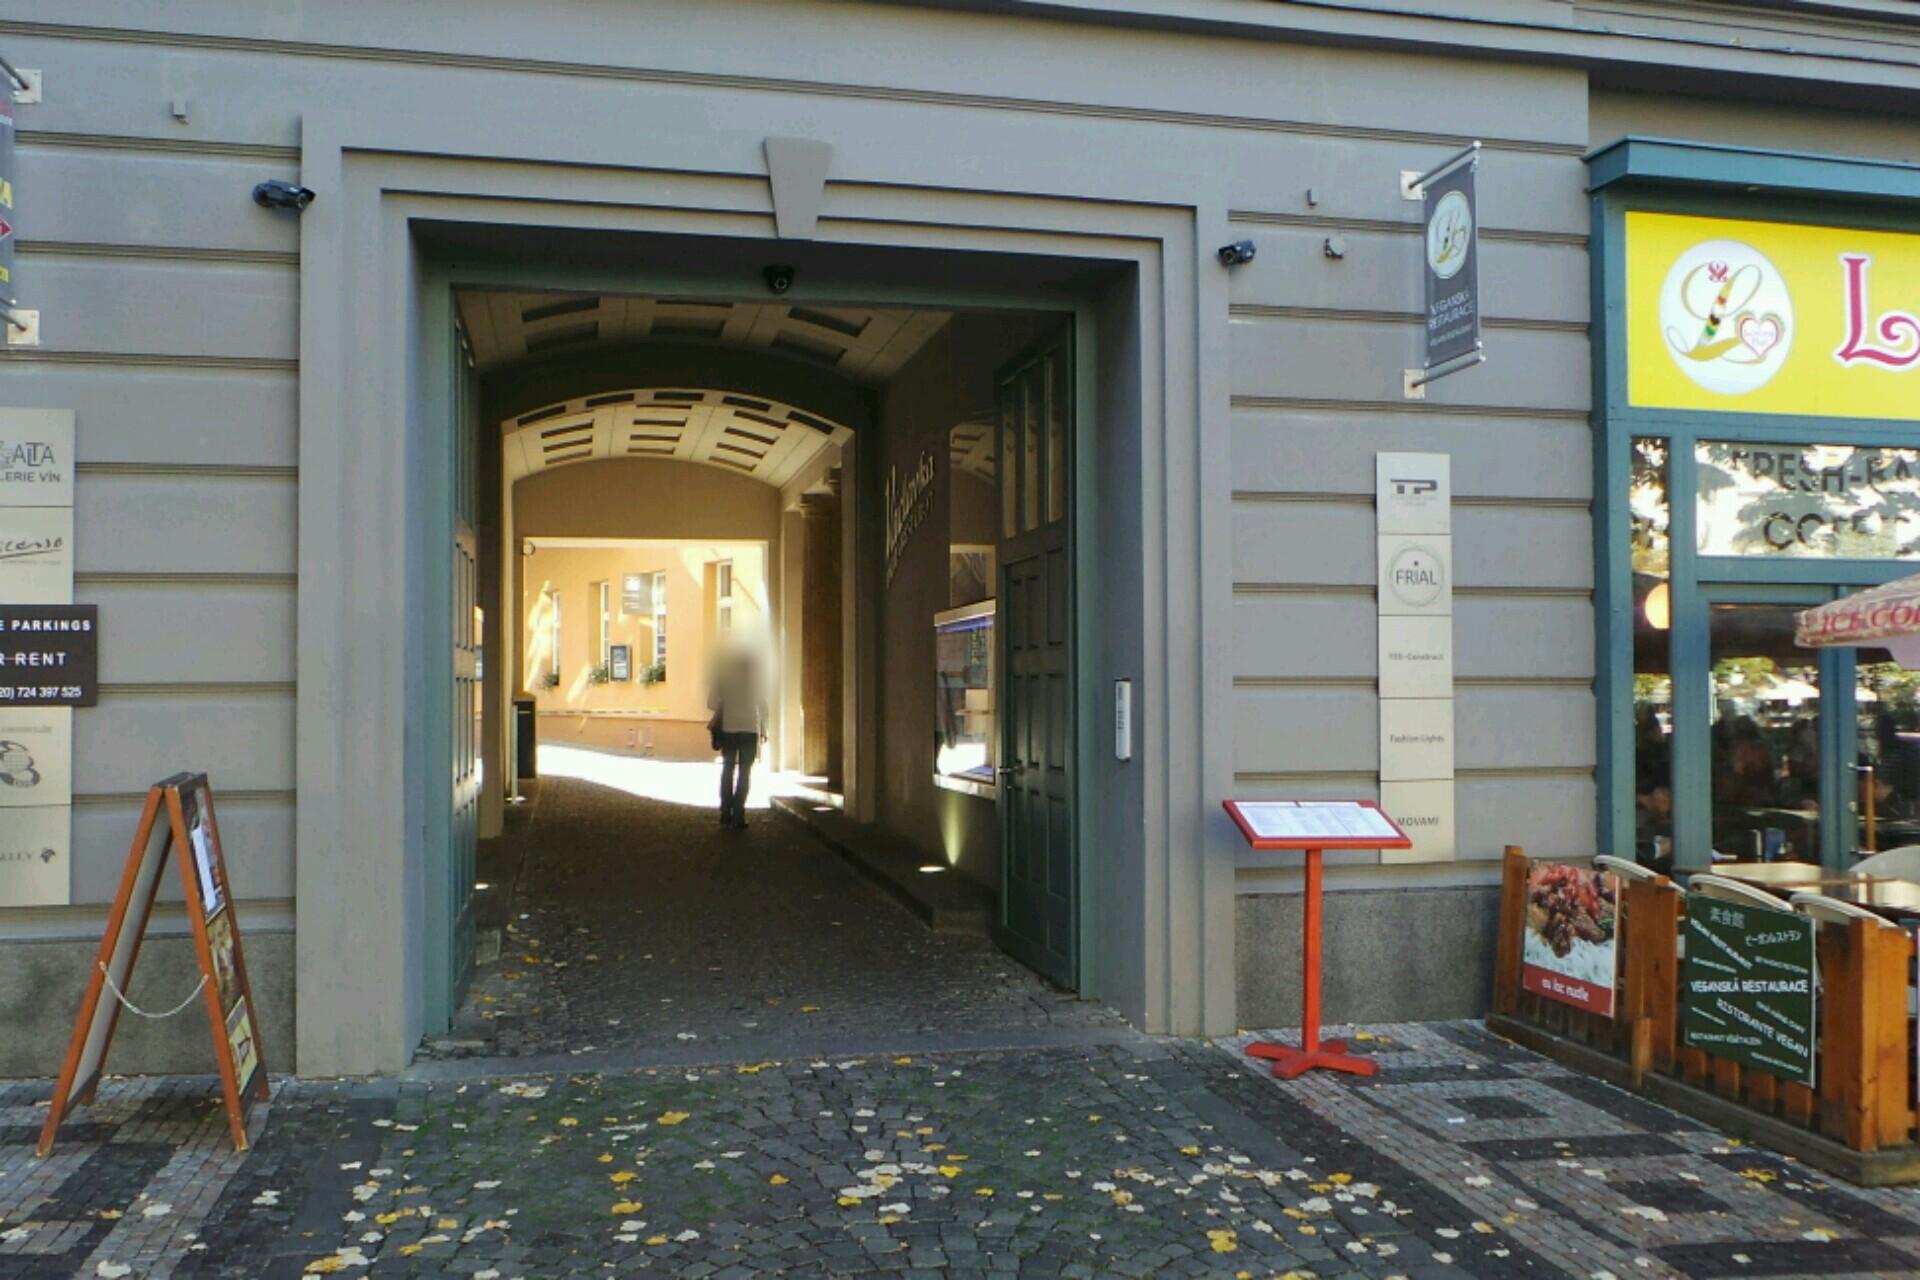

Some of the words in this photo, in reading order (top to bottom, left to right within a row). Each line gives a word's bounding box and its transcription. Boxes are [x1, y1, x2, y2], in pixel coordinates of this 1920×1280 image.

[1396, 570, 1437, 585] FRIAL
[11, 620, 91, 631] PARKINGS
[15, 652, 66, 666] RENT
[17, 686, 37, 698] 724
[39, 686, 60, 698] 397
[1398, 816, 1439, 827] MOVAMI
[1691, 977, 1740, 993] VEGANSKÁ
[1742, 979, 1809, 993] RESTAURACE
